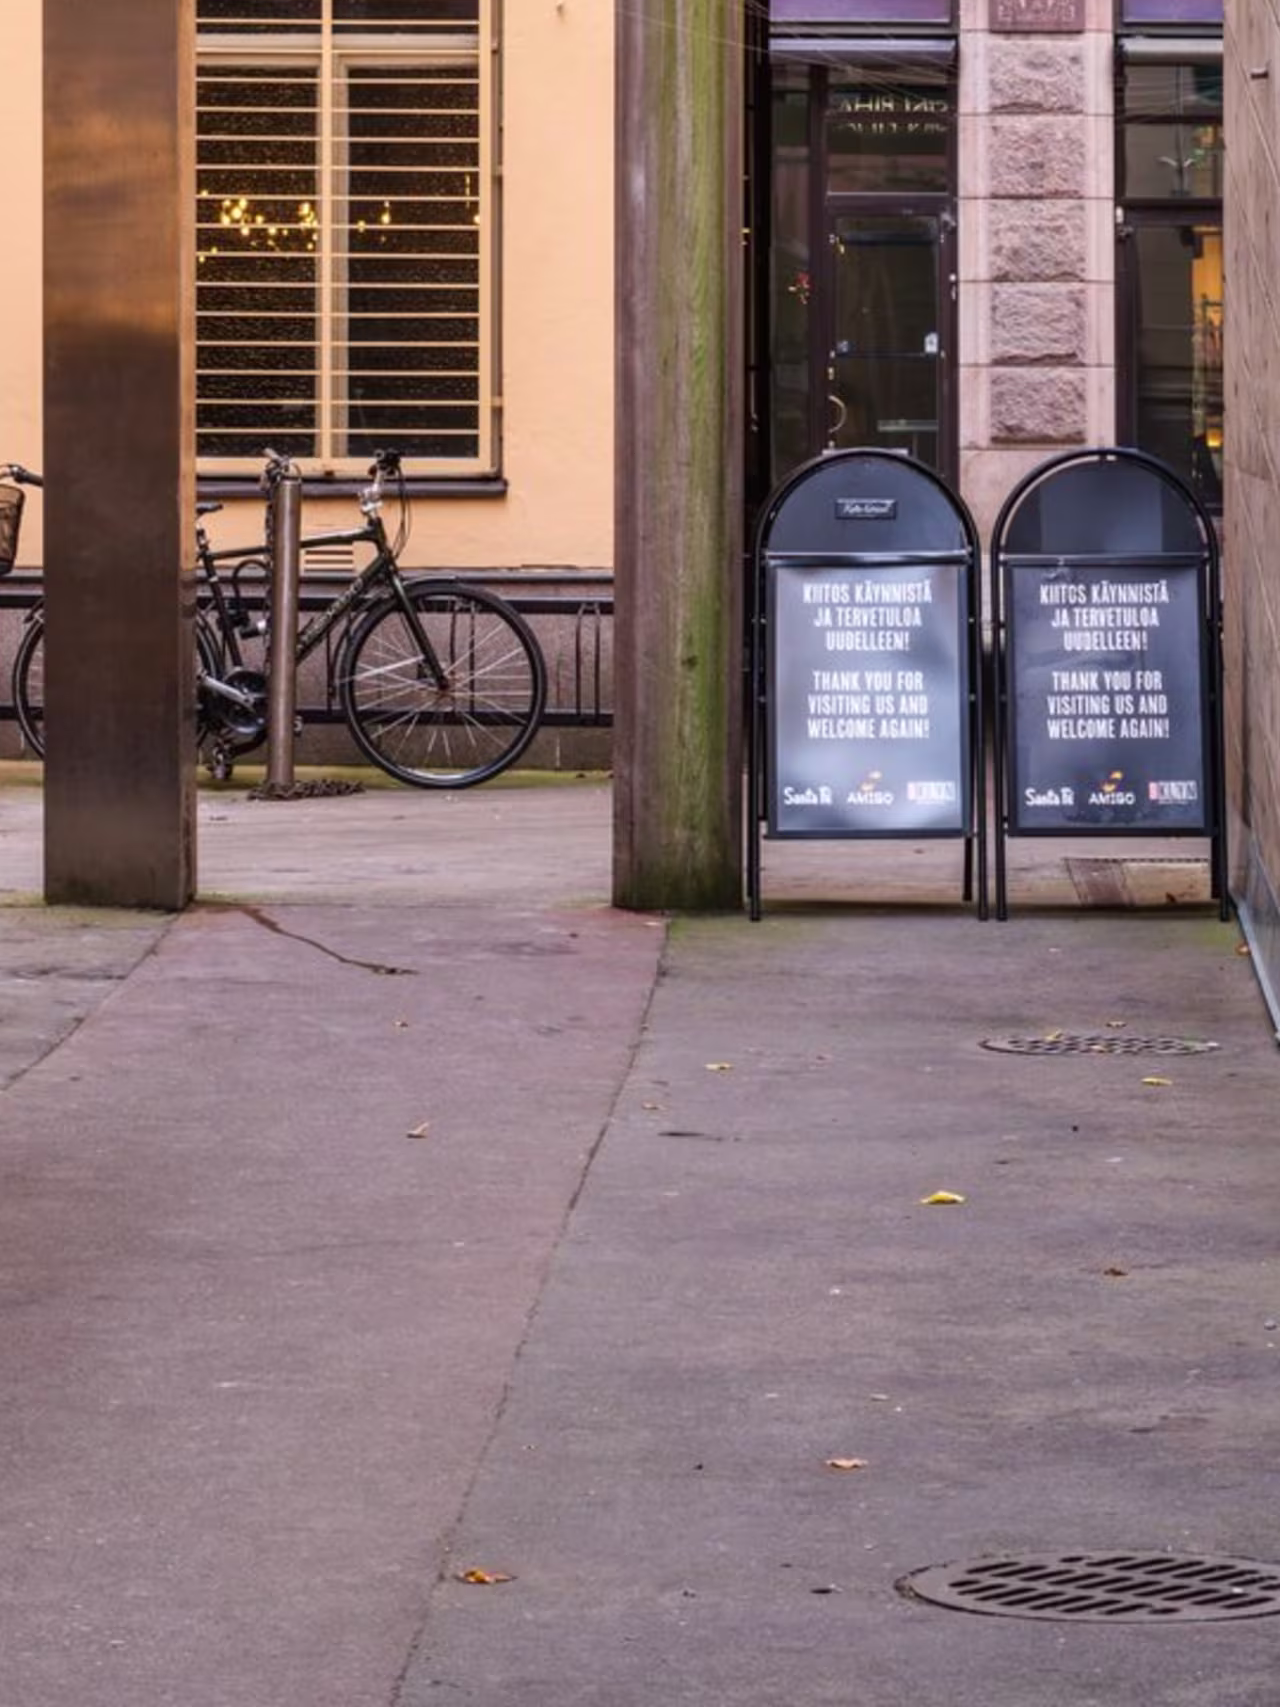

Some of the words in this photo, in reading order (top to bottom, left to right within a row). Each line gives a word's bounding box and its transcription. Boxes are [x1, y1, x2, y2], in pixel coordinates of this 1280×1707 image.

[803, 583, 850, 603] KIITOS
[855, 580, 932, 603] KÄYNNISTÄ
[1040, 584, 1087, 604] KIITOS
[1091, 580, 1169, 603] KÄYNNISTÄ
[813, 607, 832, 627] JA
[836, 607, 922, 627] TERVETULOA
[1051, 607, 1070, 627] JA
[1073, 607, 1160, 627] TERVETULOA
[826, 631, 909, 651] UUDELLEEN!
[1064, 631, 1148, 651] UUDELLEEN!
[813, 671, 860, 691] THANK
[864, 671, 892, 691] YOU
[897, 671, 923, 691] FOR
[1052, 671, 1099, 691] THANK
[1103, 671, 1131, 691] YOU
[1135, 671, 1162, 691] FOR
[808, 695, 870, 715] VISITING
[876, 695, 895, 715] US
[899, 695, 927, 715] AND
[1047, 695, 1110, 715] VISITING
[1115, 695, 1135, 715] US
[1138, 695, 1168, 715] AND
[807, 719, 875, 738] WELCOME
[879, 719, 929, 738] AGAIN!
[1047, 719, 1116, 739] WELCOME
[1120, 719, 1169, 739] AGAIN!
[847, 792, 894, 805] AMIGO
[1088, 792, 1136, 805] AMIGO
